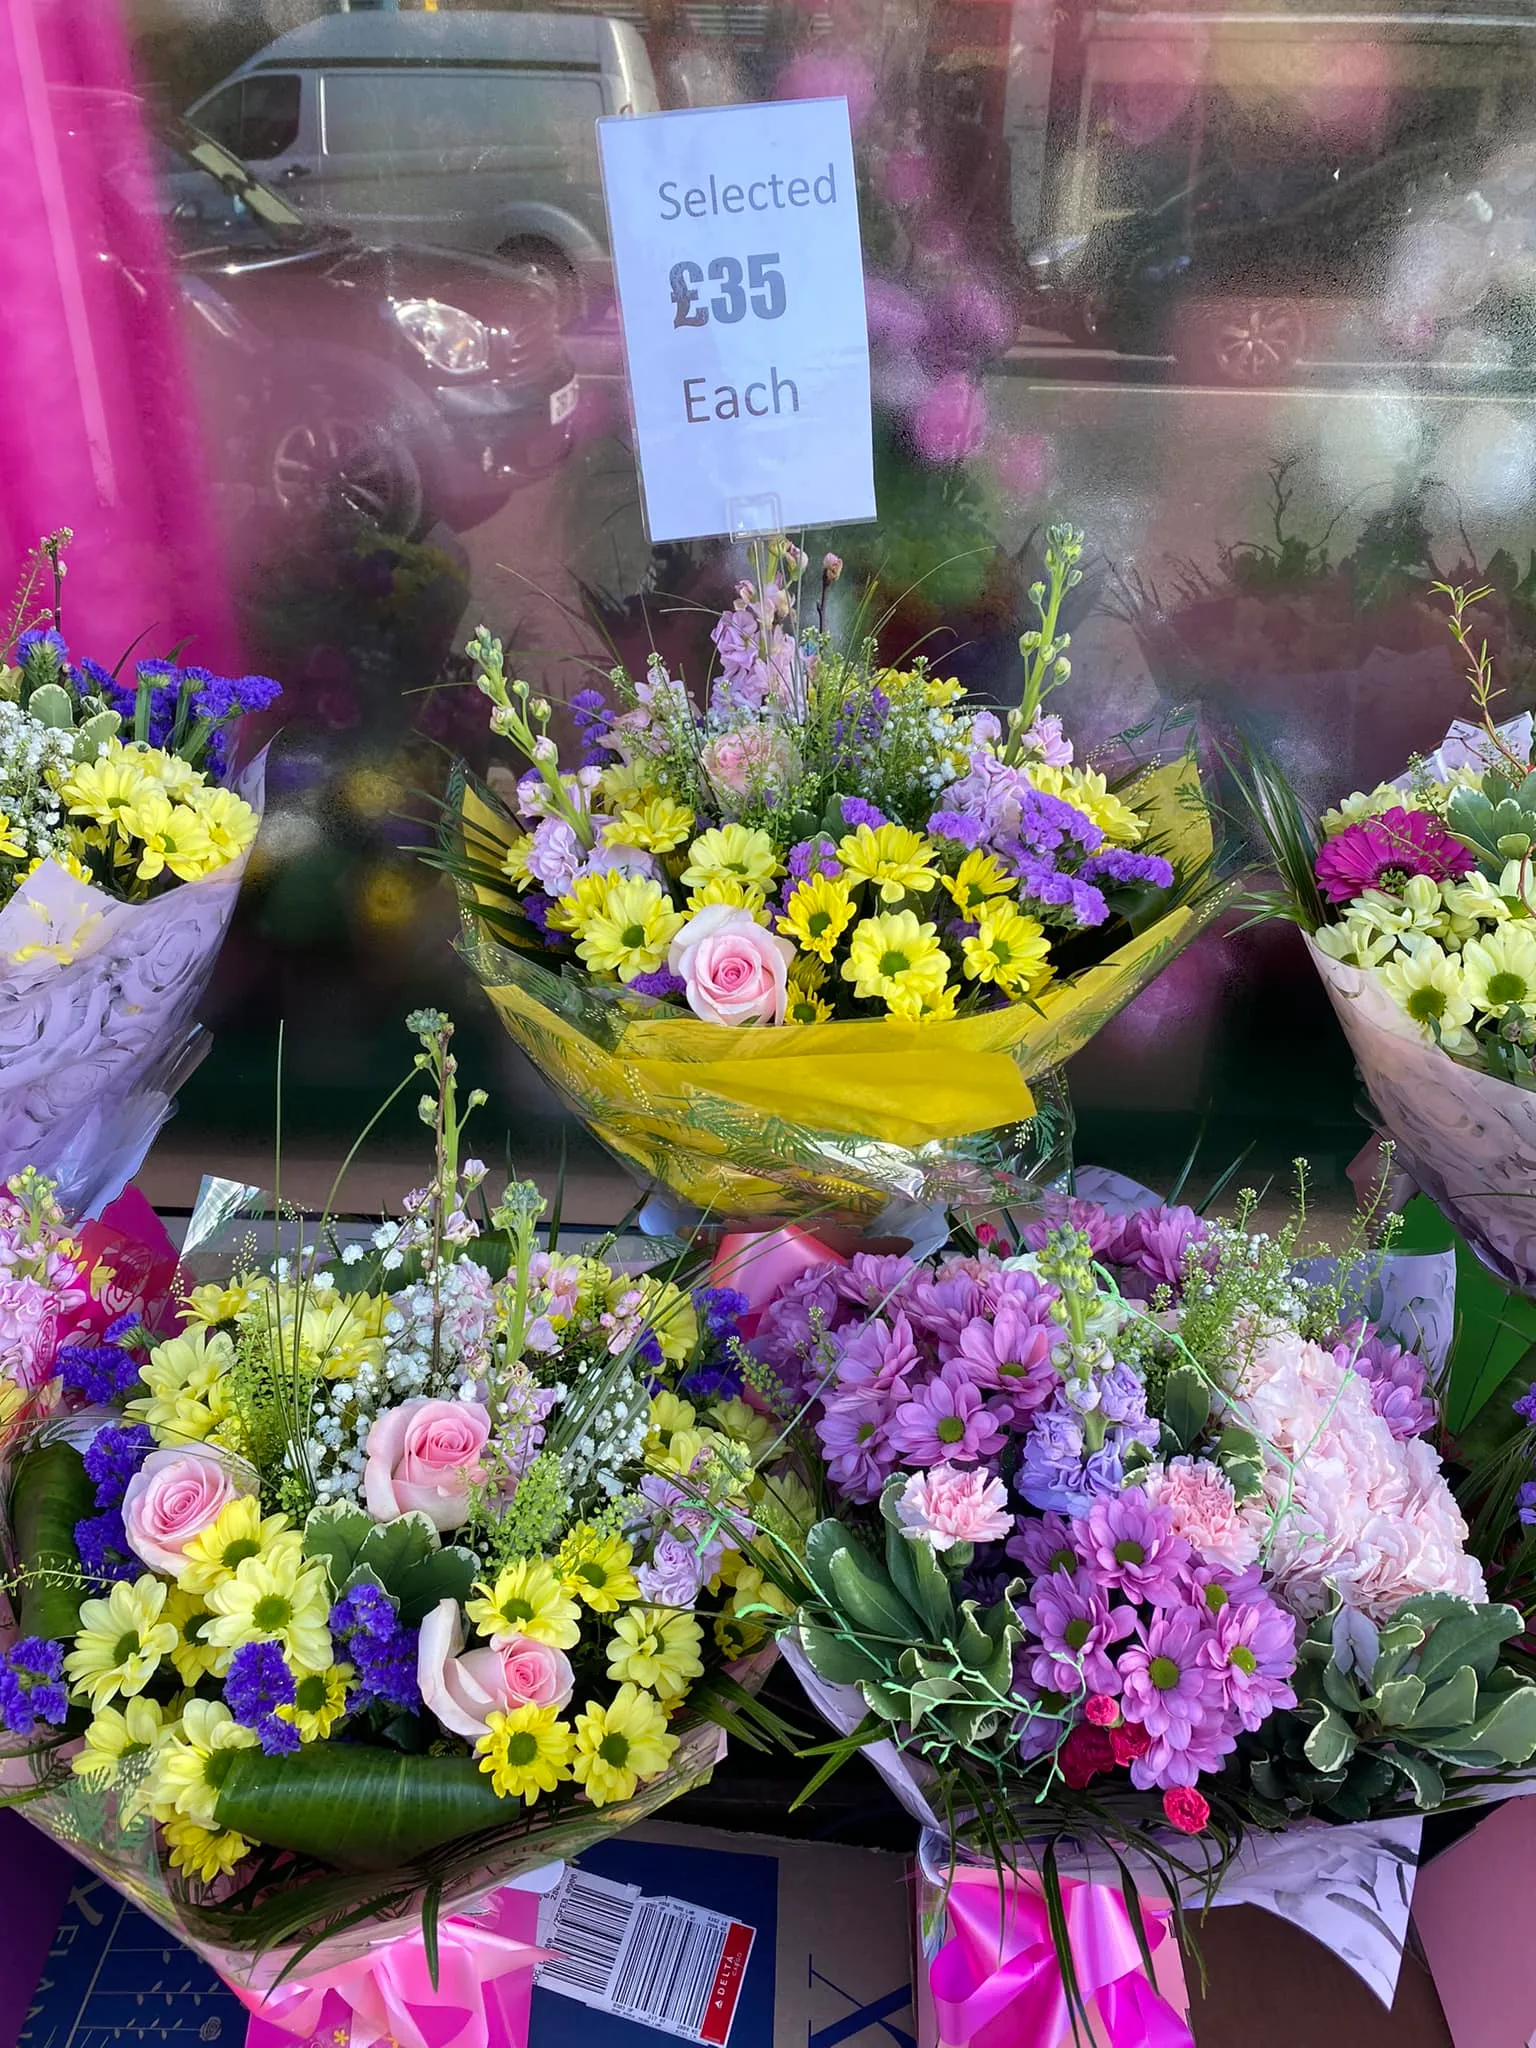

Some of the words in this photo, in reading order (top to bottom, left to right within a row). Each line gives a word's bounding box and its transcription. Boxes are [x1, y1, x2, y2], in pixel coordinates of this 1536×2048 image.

[659, 163, 837, 221] Selected
[669, 252, 787, 329] £35
[683, 367, 799, 423] Each
[717, 1956, 734, 1996] DELTA
